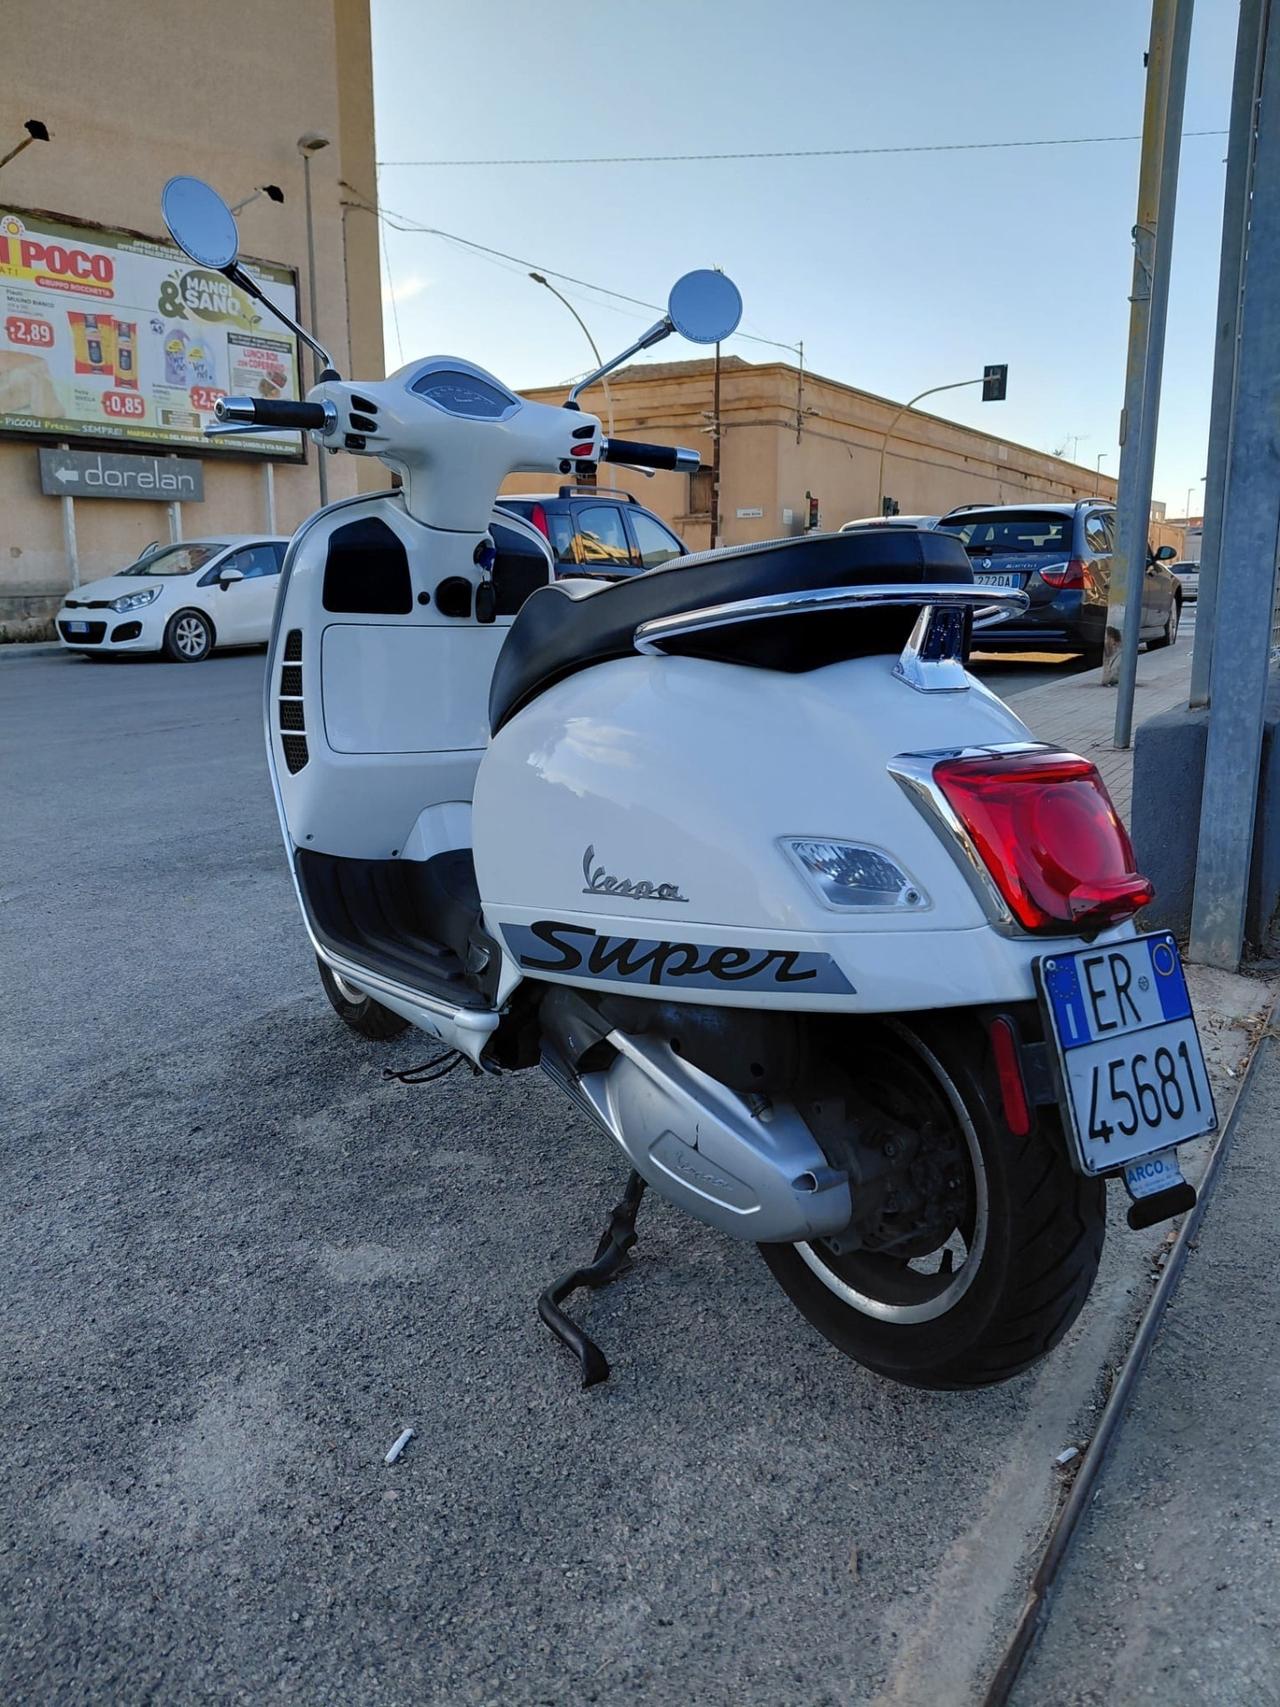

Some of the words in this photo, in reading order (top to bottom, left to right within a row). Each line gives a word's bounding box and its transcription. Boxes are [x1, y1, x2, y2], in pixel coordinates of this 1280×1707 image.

[21, 240, 114, 283] POCO
[40, 278, 70, 290] GRUPPO
[70, 282, 111, 296] ROCCHETTA
[185, 289, 241, 315] SANO
[186, 276, 232, 297] MANGI
[5, 416, 41, 428] PICCOLI
[84, 456, 195, 491] dorelan
[582, 844, 690, 902] Vespa
[520, 920, 817, 986] Super
[1083, 952, 1142, 1032] ER
[1088, 1040, 1201, 1143] 45681
[1128, 1159, 1164, 1184] ARCO
